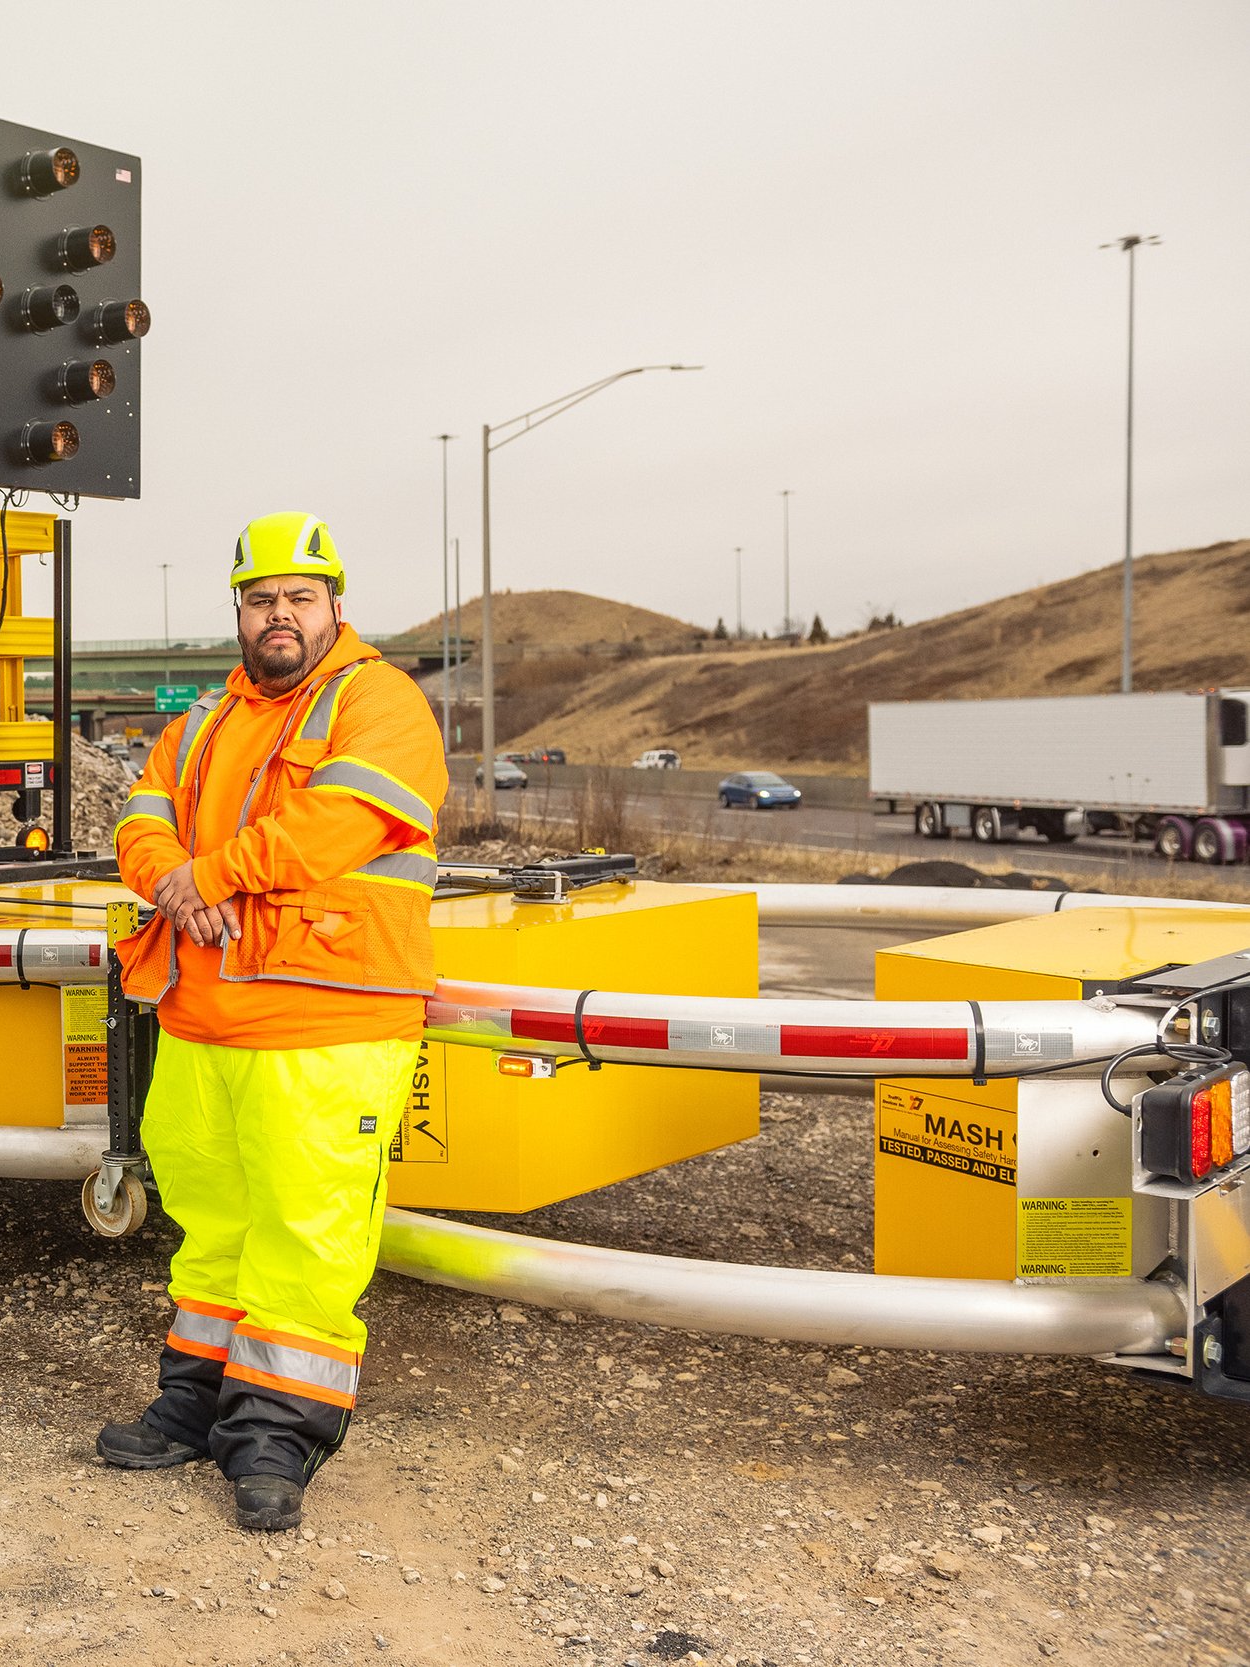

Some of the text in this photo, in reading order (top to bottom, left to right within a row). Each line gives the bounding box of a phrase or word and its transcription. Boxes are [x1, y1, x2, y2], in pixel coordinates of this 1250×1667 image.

[65, 988, 97, 997] WARNING:
[66, 1034, 99, 1042] WARNING:
[403, 1107, 411, 1146] Hardware
[925, 1113, 1003, 1151] MASH
[893, 1128, 920, 1142] Manual
[921, 1136, 931, 1145] for
[933, 1137, 971, 1157] Assessing
[973, 1147, 998, 1163] Safety
[881, 1138, 924, 1161] TESTED,
[927, 1151, 970, 1171] PASSED
[972, 1163, 997, 1178] AND
[1021, 1200, 1067, 1210] WARNING:
[1020, 1264, 1067, 1274] WARNING:
